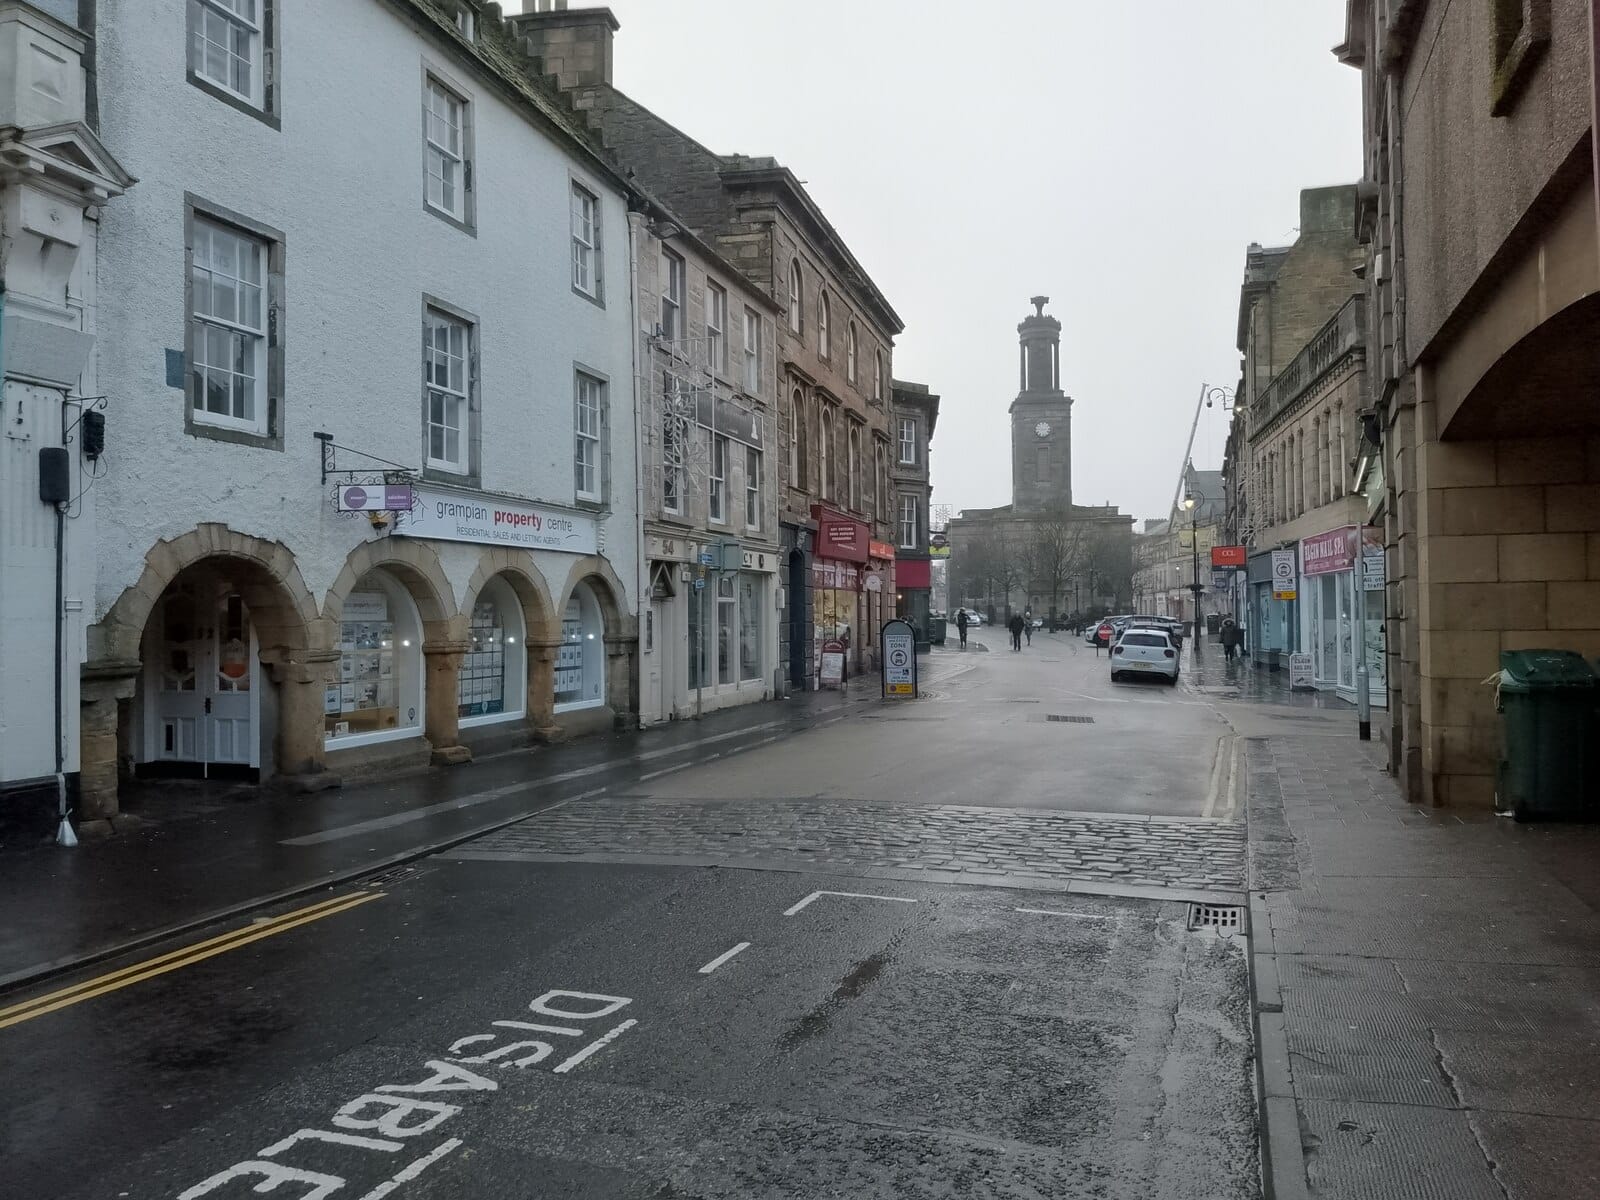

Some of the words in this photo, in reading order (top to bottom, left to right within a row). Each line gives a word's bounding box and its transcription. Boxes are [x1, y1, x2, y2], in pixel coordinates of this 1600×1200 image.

[436, 501, 488, 522] grampian
[494, 510, 543, 531] property
[547, 517, 573, 532] centre
[456, 526, 491, 538] RESIDENTIAL
[492, 529, 510, 541] SALES
[510, 532, 522, 542] AND
[522, 533, 542, 544] LETTING
[543, 535, 561, 546] AGENTS
[1304, 542, 1320, 561] ELGIN
[1320, 538, 1334, 559] NAIL
[1334, 536, 1345, 556] SPA
